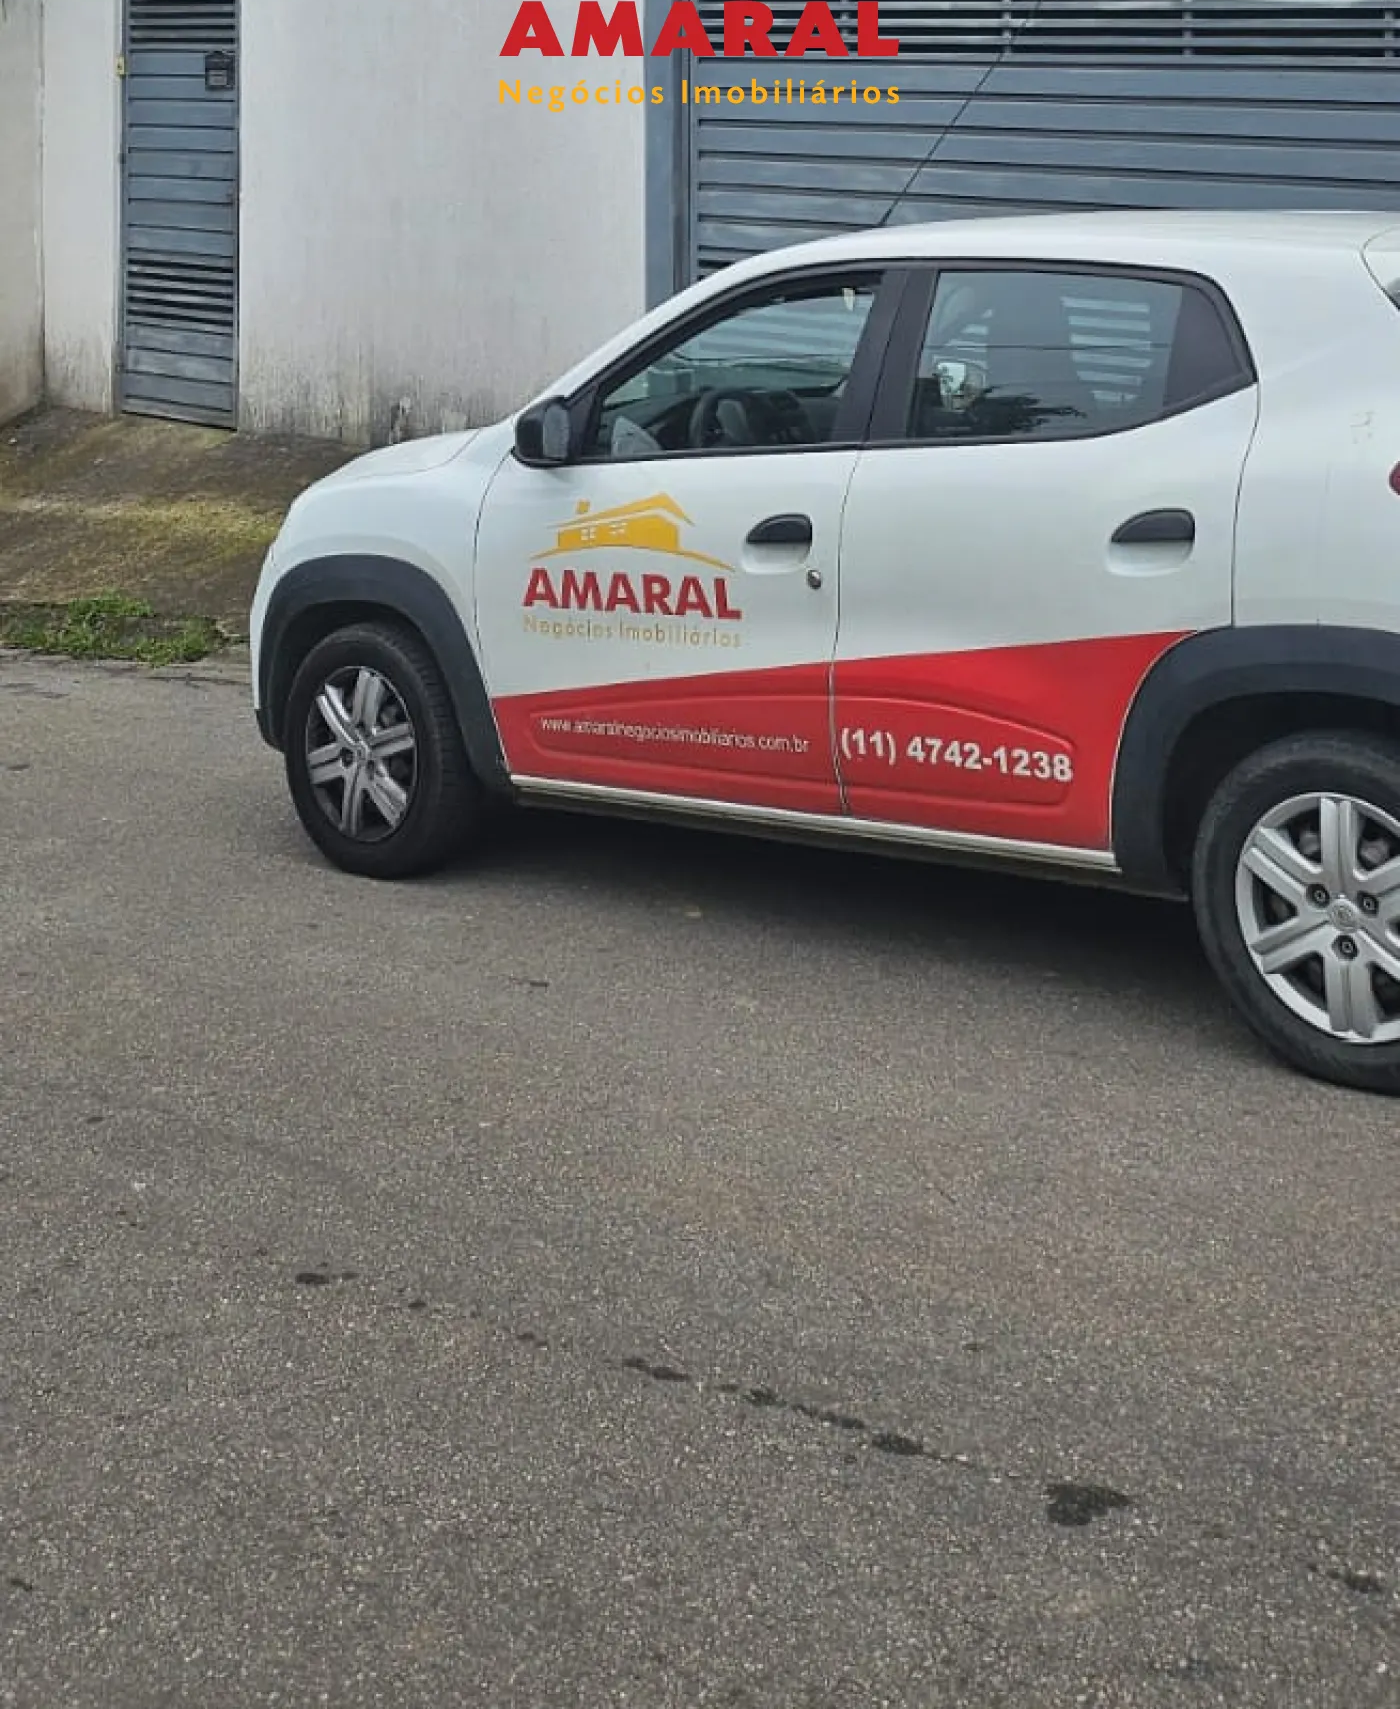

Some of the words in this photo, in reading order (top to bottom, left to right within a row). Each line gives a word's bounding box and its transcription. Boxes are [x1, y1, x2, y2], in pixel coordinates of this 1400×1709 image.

[522, 567, 742, 621] AMARAL
[841, 727, 896, 765] (11)
[906, 736, 1074, 783] 4742-1238
